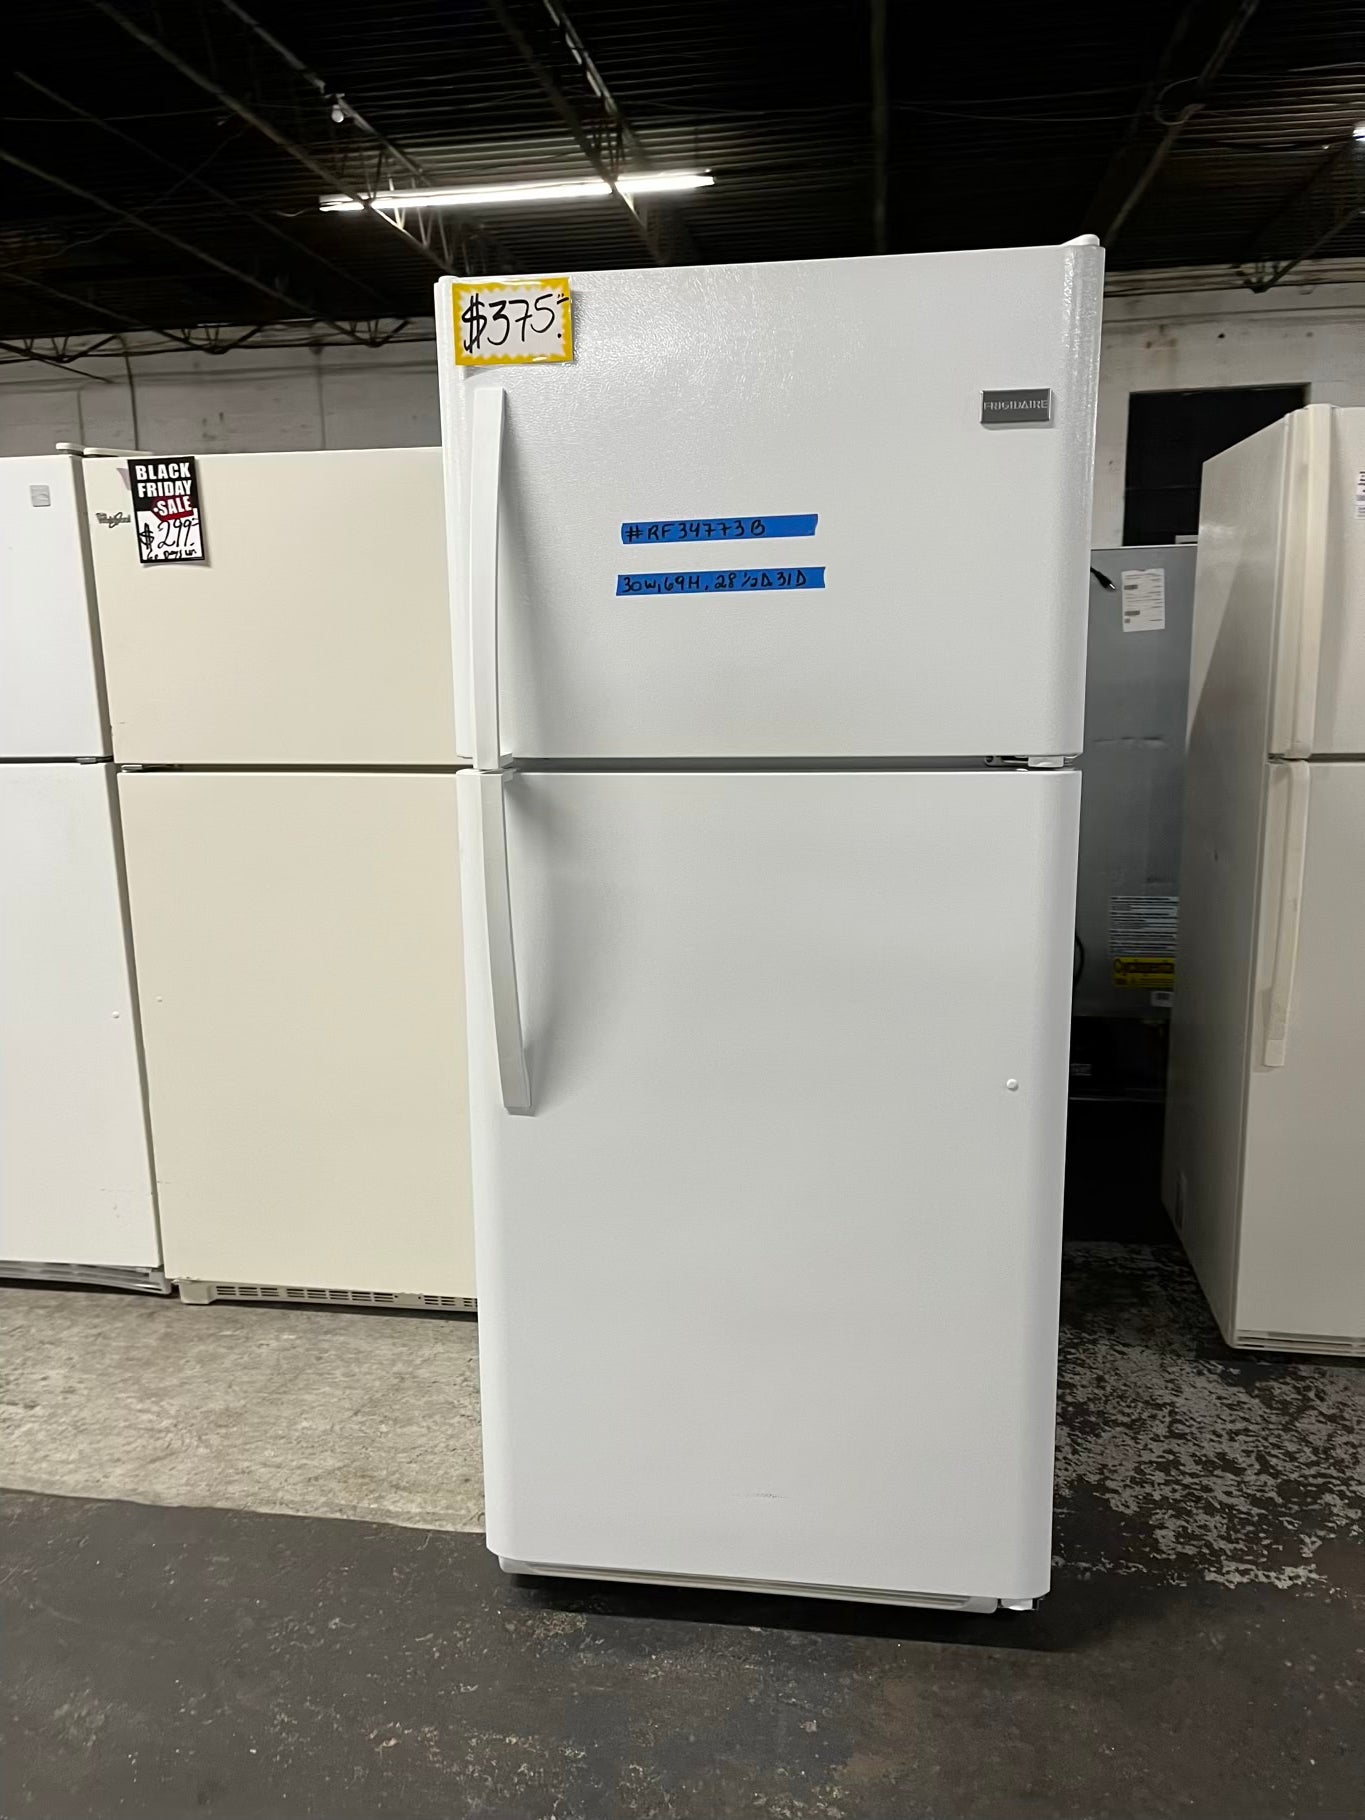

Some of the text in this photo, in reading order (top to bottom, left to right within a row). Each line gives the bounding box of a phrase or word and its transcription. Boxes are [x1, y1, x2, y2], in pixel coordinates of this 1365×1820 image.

[983, 400, 1049, 410] FRIGIDAIRE
[135, 462, 191, 480] BLACK
[137, 480, 192, 498] FRIDAY
[156, 496, 192, 516] SALE
